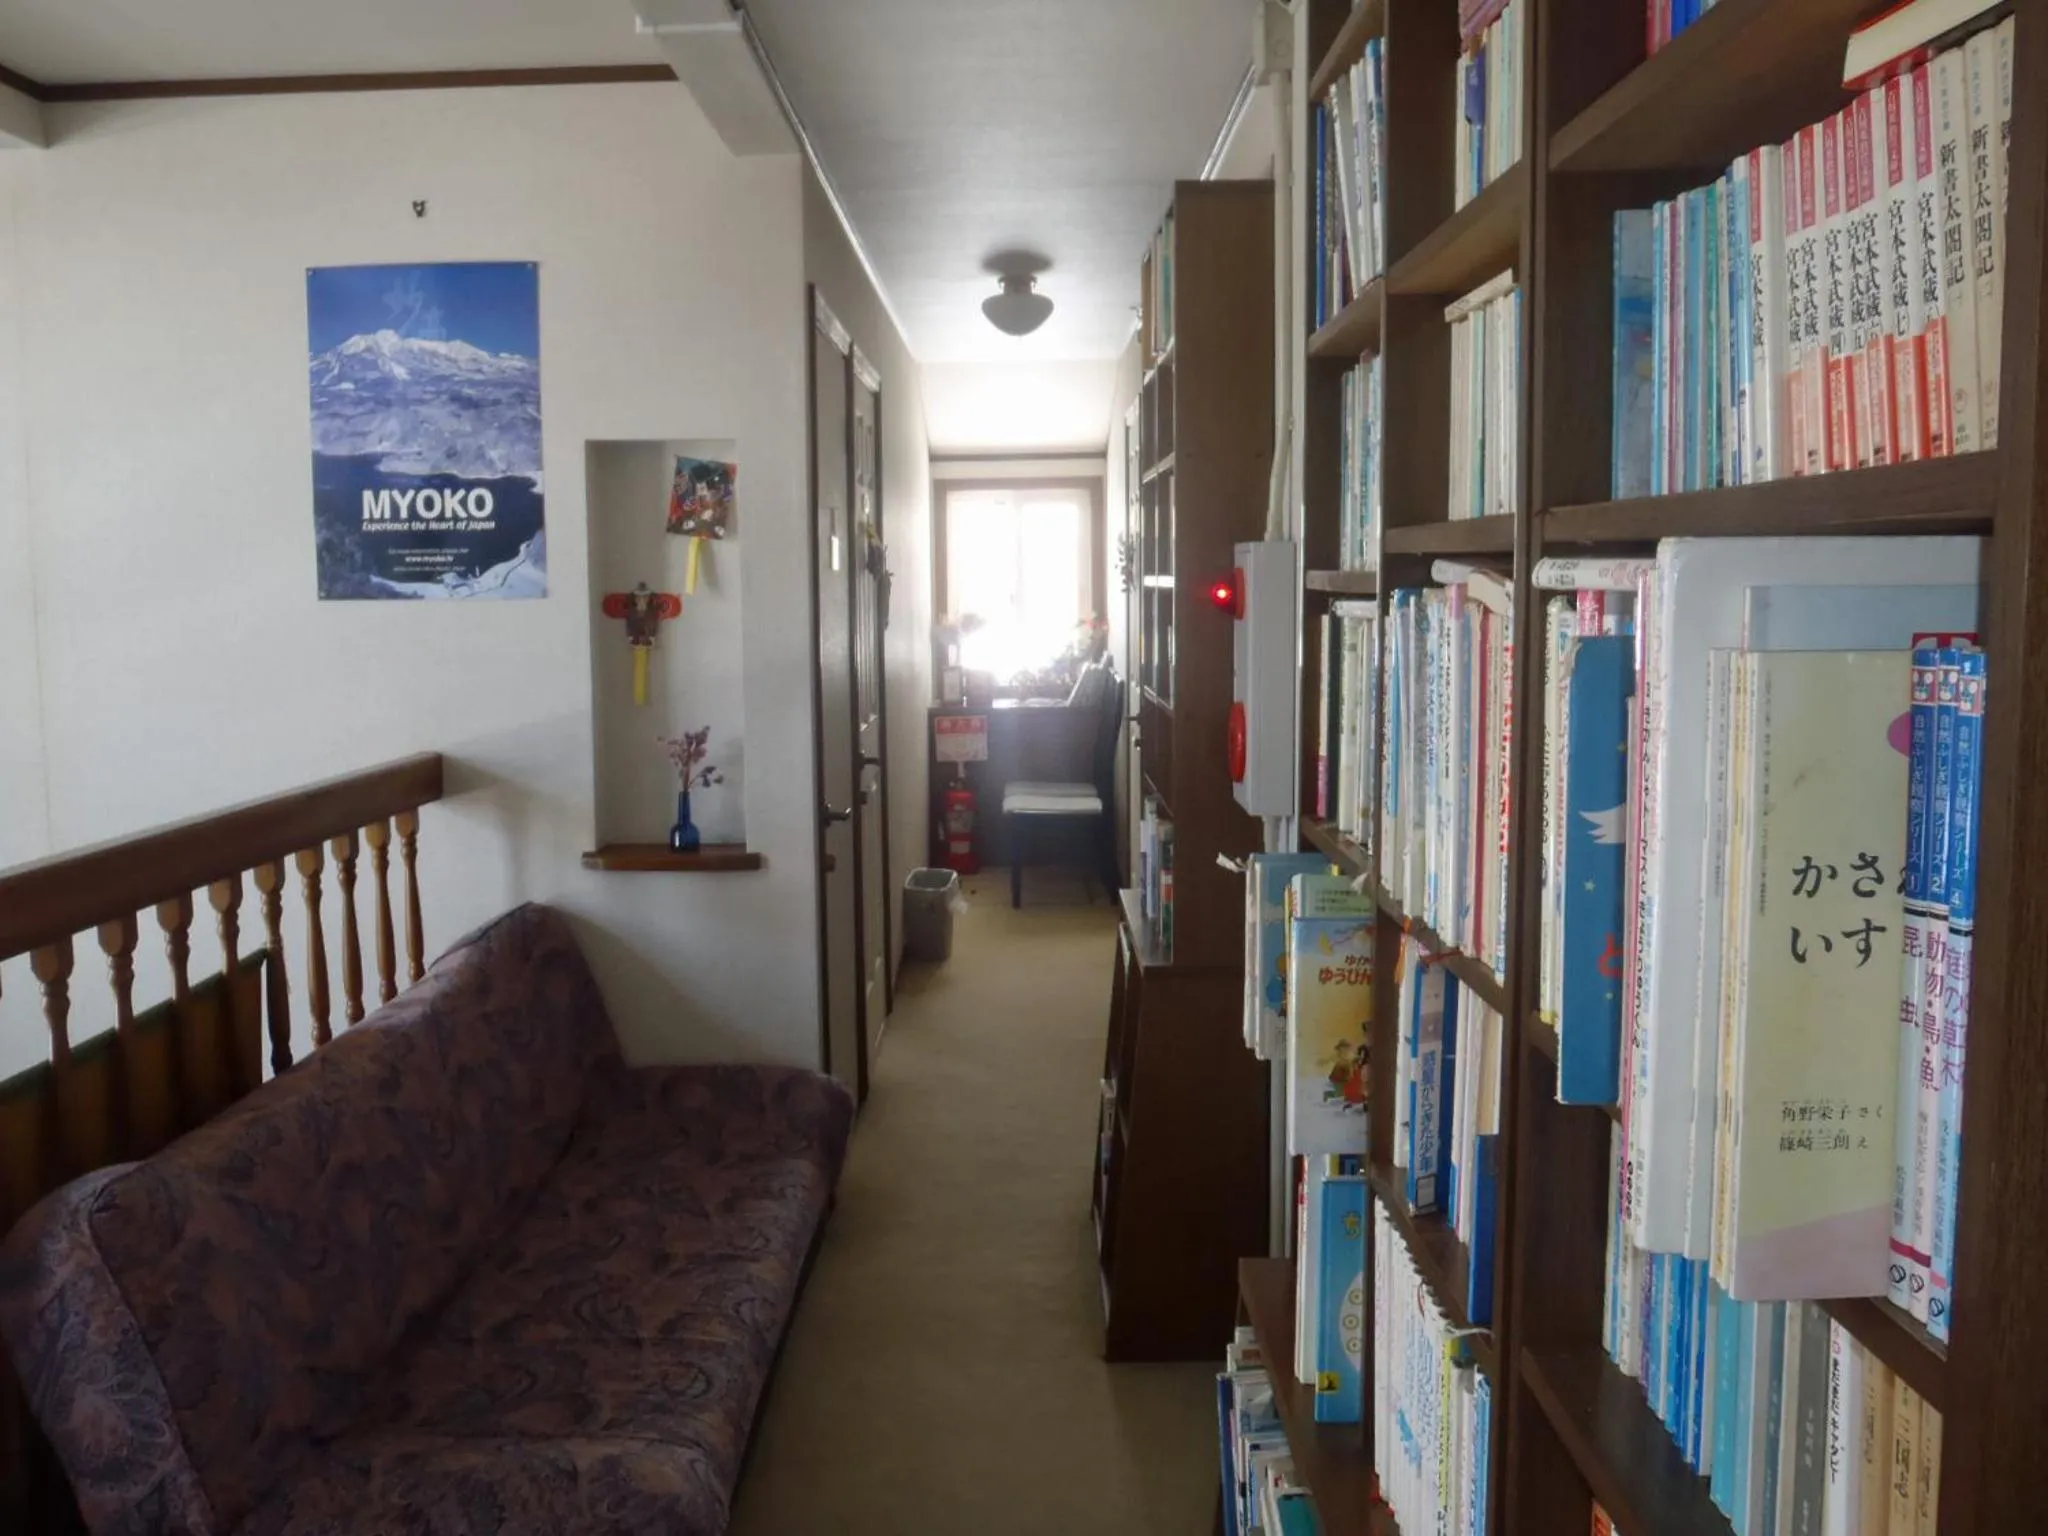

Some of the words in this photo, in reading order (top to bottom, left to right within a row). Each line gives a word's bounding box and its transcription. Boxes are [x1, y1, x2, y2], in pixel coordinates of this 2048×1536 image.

[362, 487, 494, 519] MYOKO
[362, 521, 409, 531] Experience
[411, 520, 426, 530] the
[429, 520, 454, 530] Heart
[456, 519, 468, 530] of
[468, 520, 495, 531] Japan
[1792, 852, 1907, 899] かさ
[1791, 917, 1887, 969] いす
